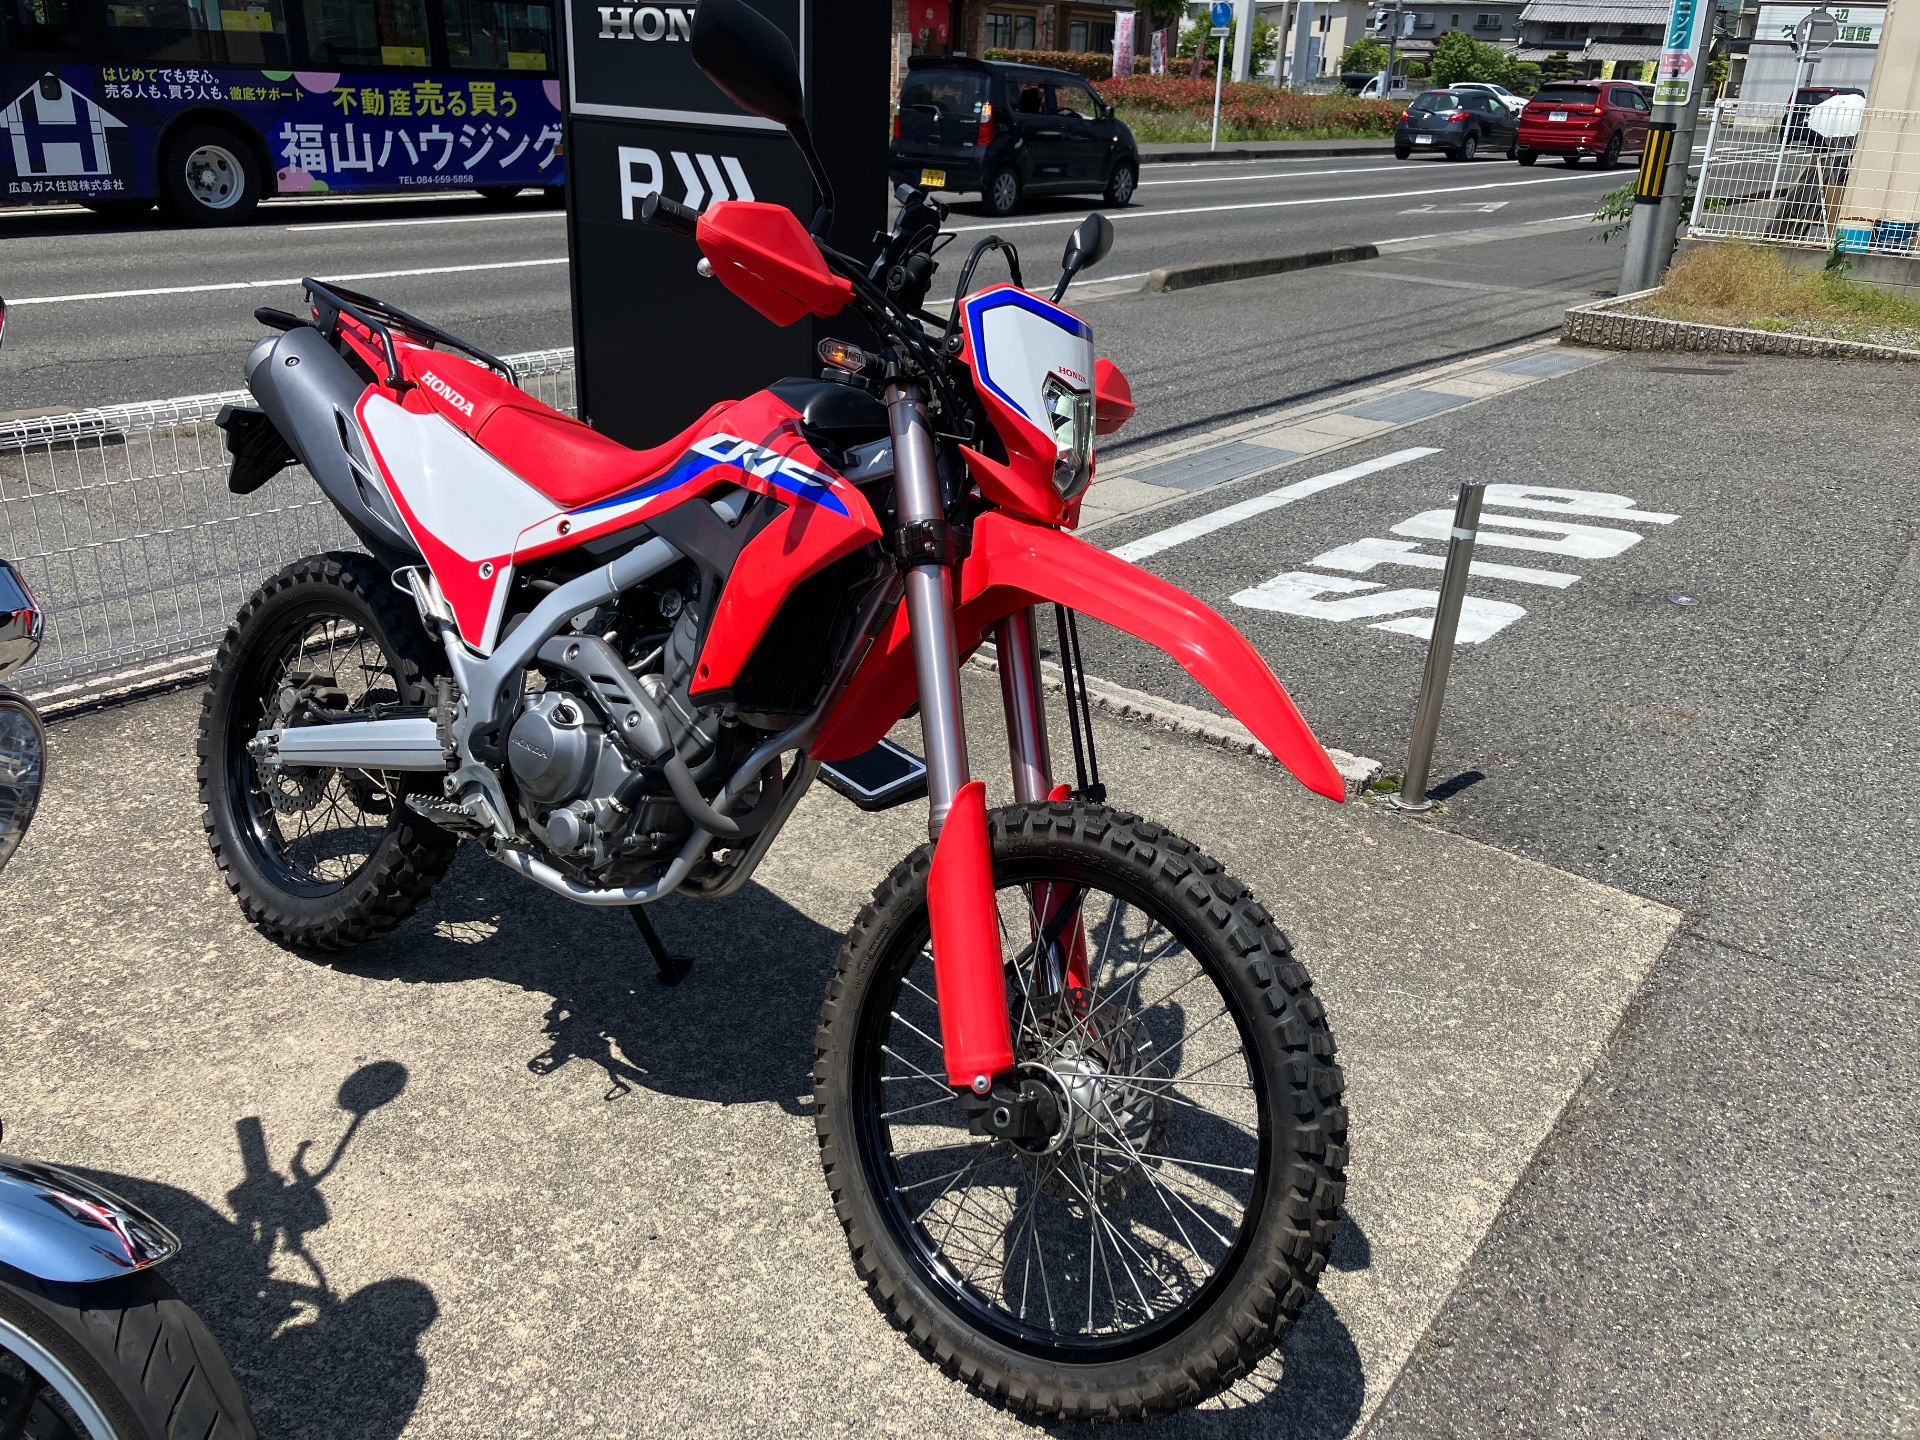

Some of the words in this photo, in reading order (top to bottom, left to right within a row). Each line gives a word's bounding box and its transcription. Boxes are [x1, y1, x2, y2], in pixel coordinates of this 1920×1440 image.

[598, 6, 696, 42] HON
[103, 67, 220, 84] はじめてでも安心。
[104, 84, 304, 101] 売る人も、買う人も、徹底サポート
[331, 80, 517, 117] 不動産売る買う
[279, 122, 563, 174] 福山ハウジング
[8, 179, 125, 194] 広島ガス住設株式会社
[617, 146, 664, 220] P
[1057, 365, 1087, 385] HONDA
[420, 370, 475, 418] HONDA
[690, 432, 846, 490] CRF
[1229, 483, 1683, 645] STOP
[511, 734, 549, 760] HONDA
